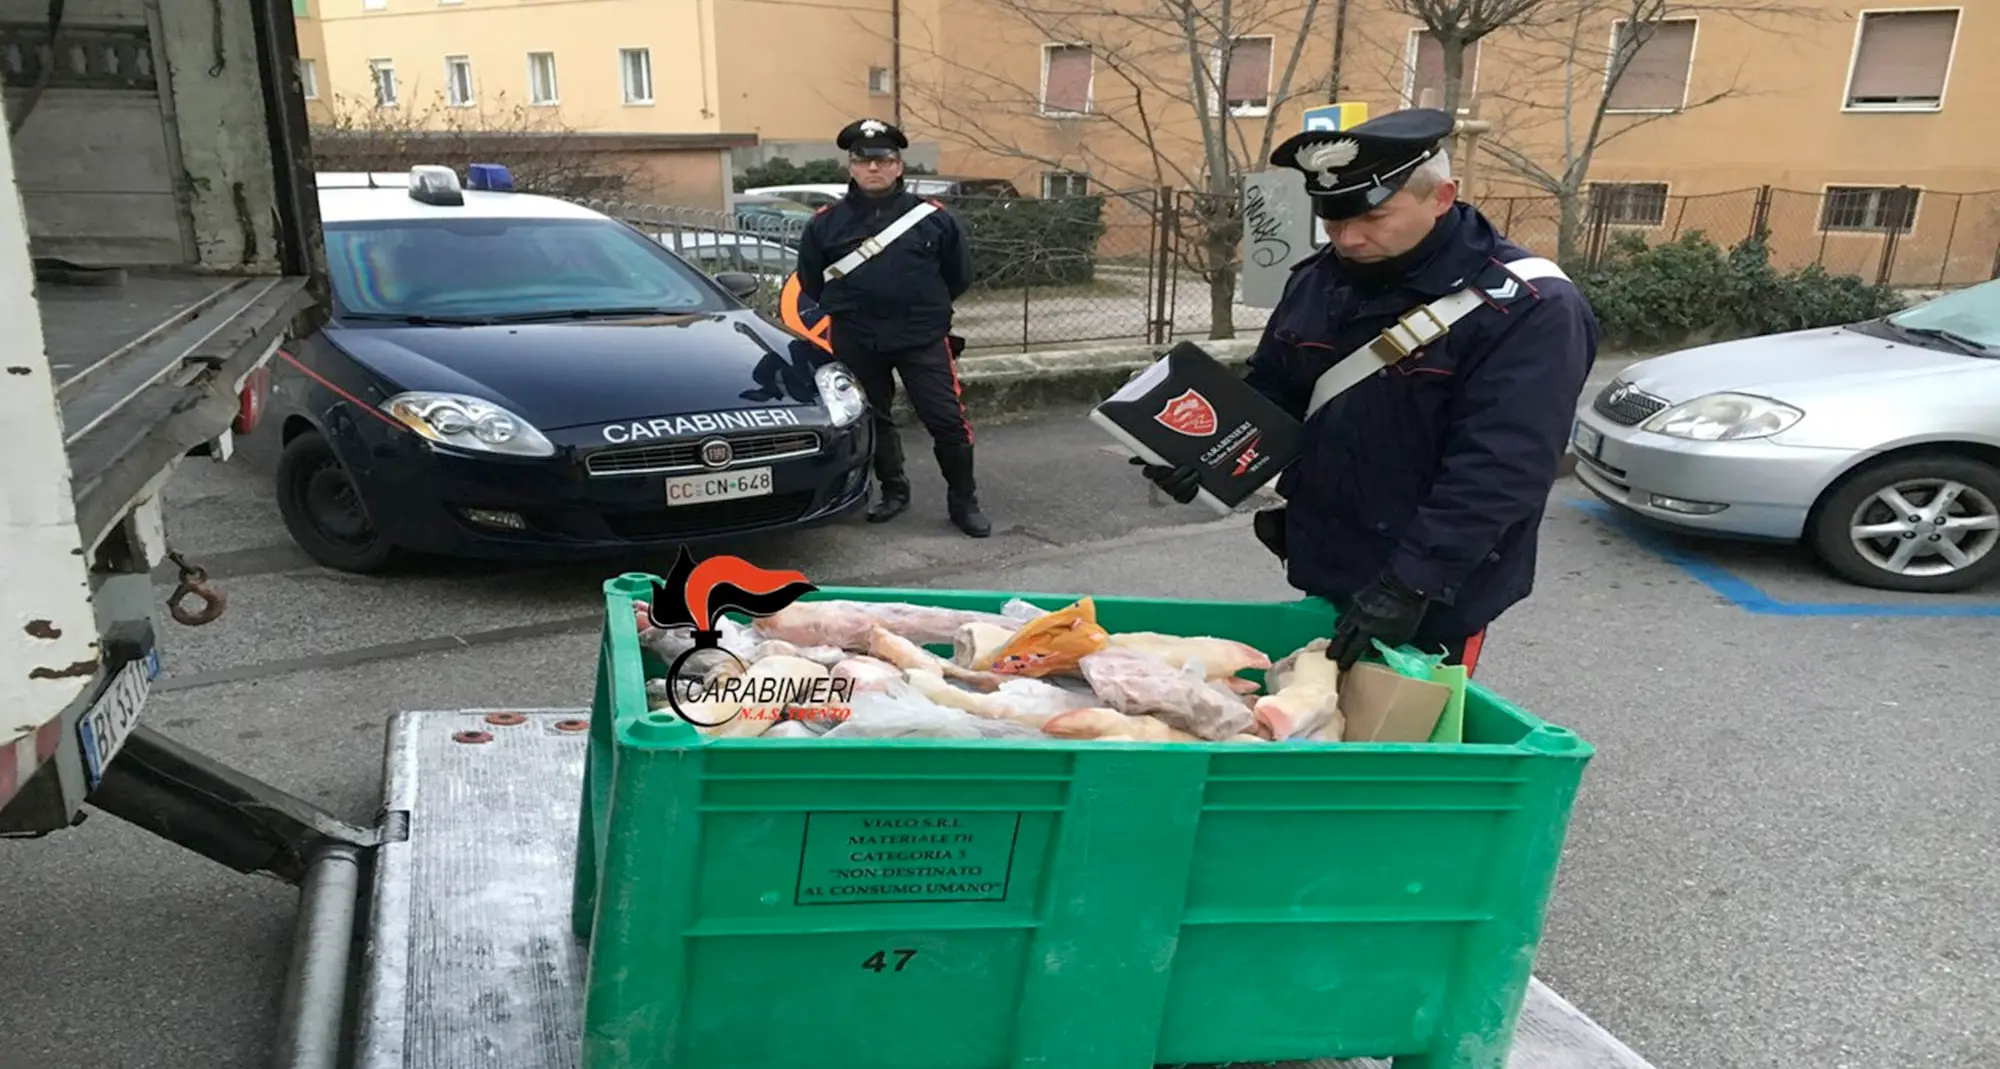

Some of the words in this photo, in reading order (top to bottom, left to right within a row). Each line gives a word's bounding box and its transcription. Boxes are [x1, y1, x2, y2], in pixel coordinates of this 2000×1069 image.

[602, 409, 800, 444] CARABINIERI
[1200, 421, 1252, 462] CARABINIERI
[708, 447, 727, 461] FIAT
[1236, 448, 1259, 467] 112
[669, 483, 693, 500] CC
[705, 479, 728, 496] CN
[737, 473, 770, 492] 648
[848, 834, 949, 845] MATERIALE
[849, 850, 952, 862] CATEGORIA
[882, 866, 982, 878] DESTINATO
[804, 886, 825, 896] AL
[829, 884, 923, 896] CONSUMO
[861, 949, 917, 973] 47
